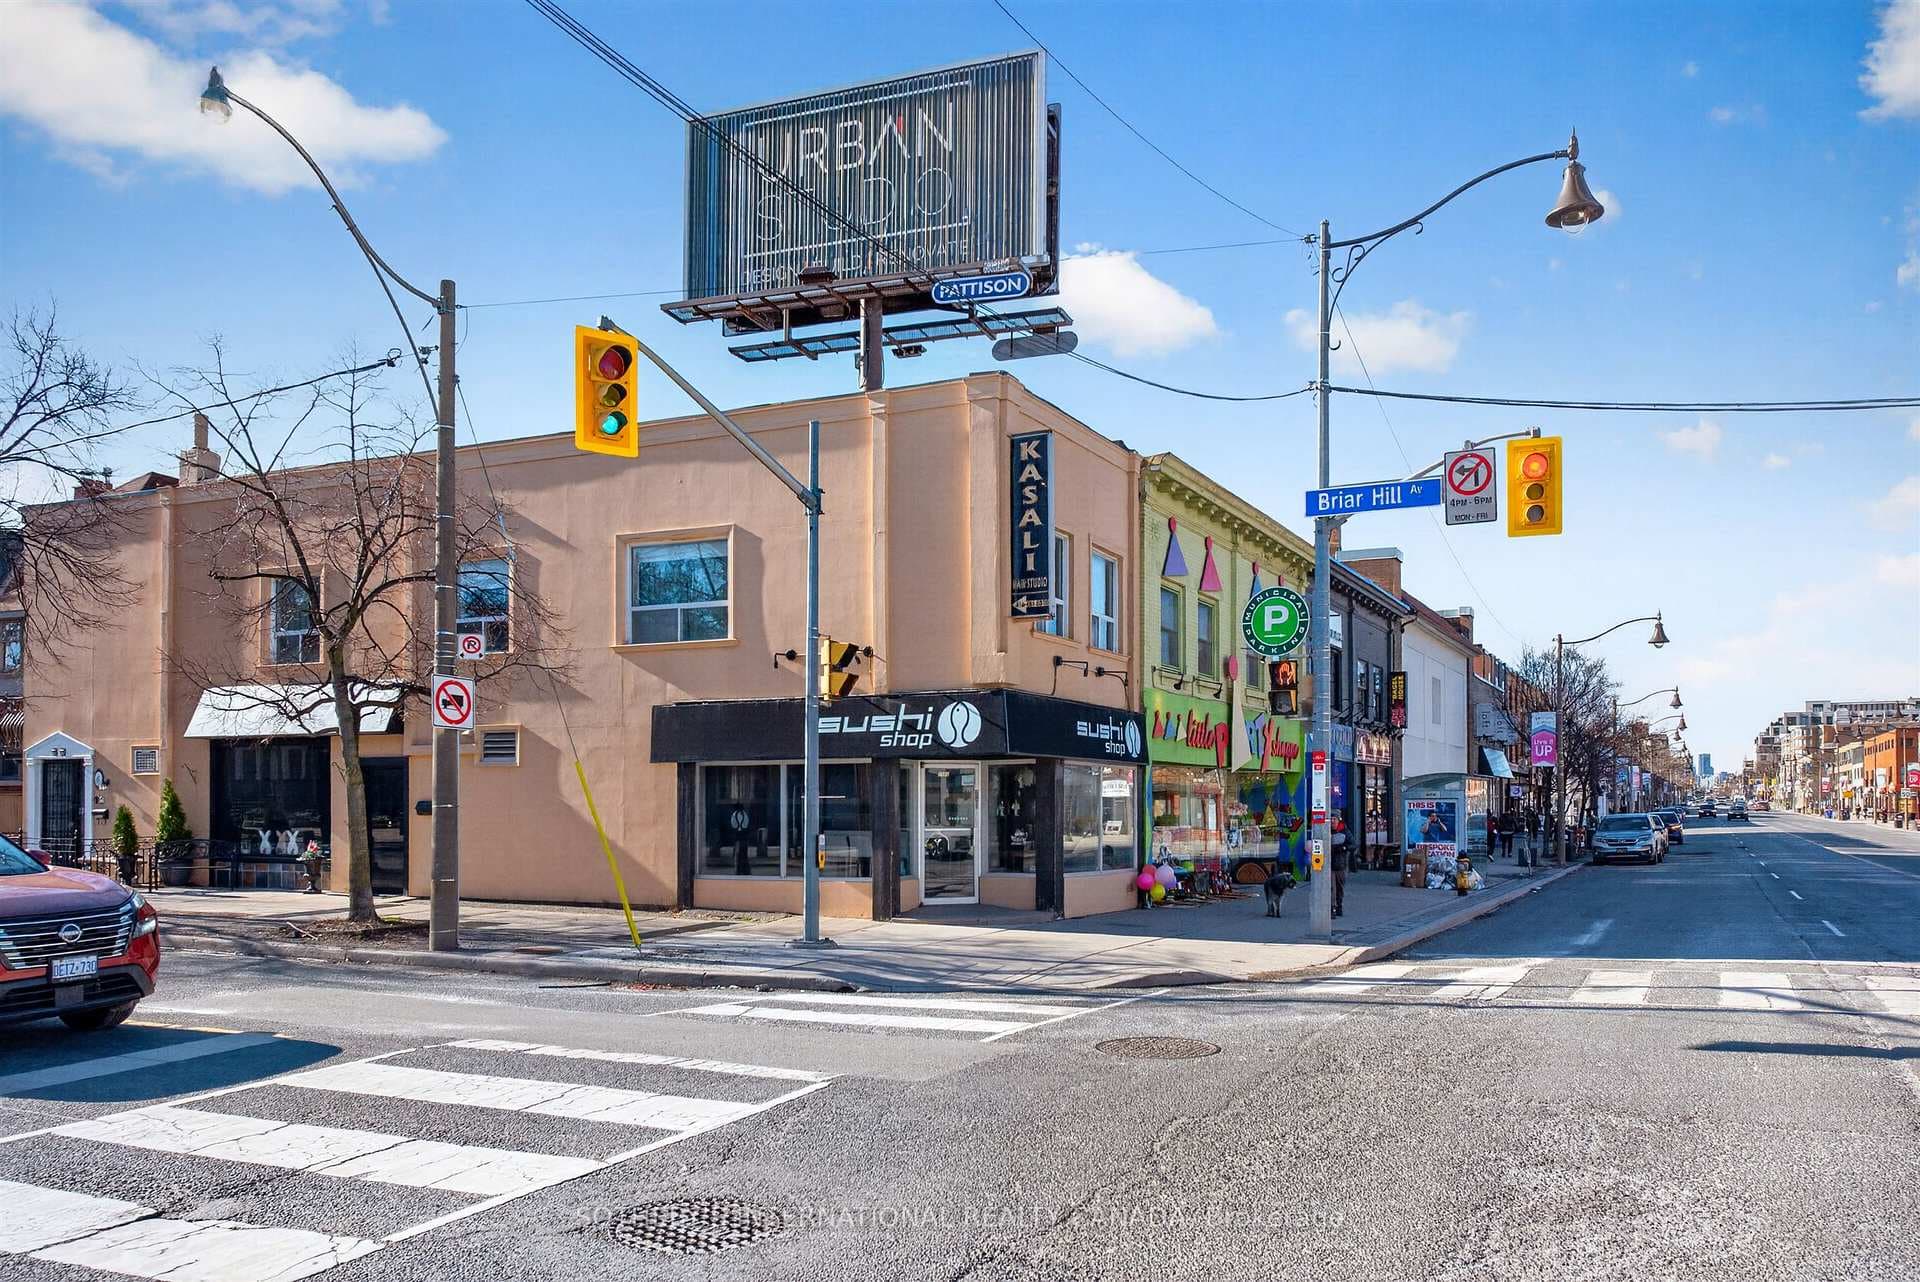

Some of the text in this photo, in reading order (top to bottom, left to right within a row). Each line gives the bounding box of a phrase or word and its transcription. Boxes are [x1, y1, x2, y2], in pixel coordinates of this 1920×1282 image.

[939, 277, 1022, 299] PATTISON
[1018, 440, 1044, 572] KASALI
[1317, 484, 1423, 512] Briar Hill Av
[1450, 498, 1468, 508] 4PM
[1473, 496, 1493, 506] 6PM
[1454, 514, 1471, 522] MON
[1476, 512, 1489, 521] FRI
[1245, 590, 1307, 621] MUNICIPAL
[1264, 605, 1289, 632] P
[818, 703, 933, 734] sushi
[1076, 716, 1123, 741] sushi
[879, 731, 932, 749] shop
[1105, 741, 1126, 758] shop
[1535, 745, 1553, 757] UP
